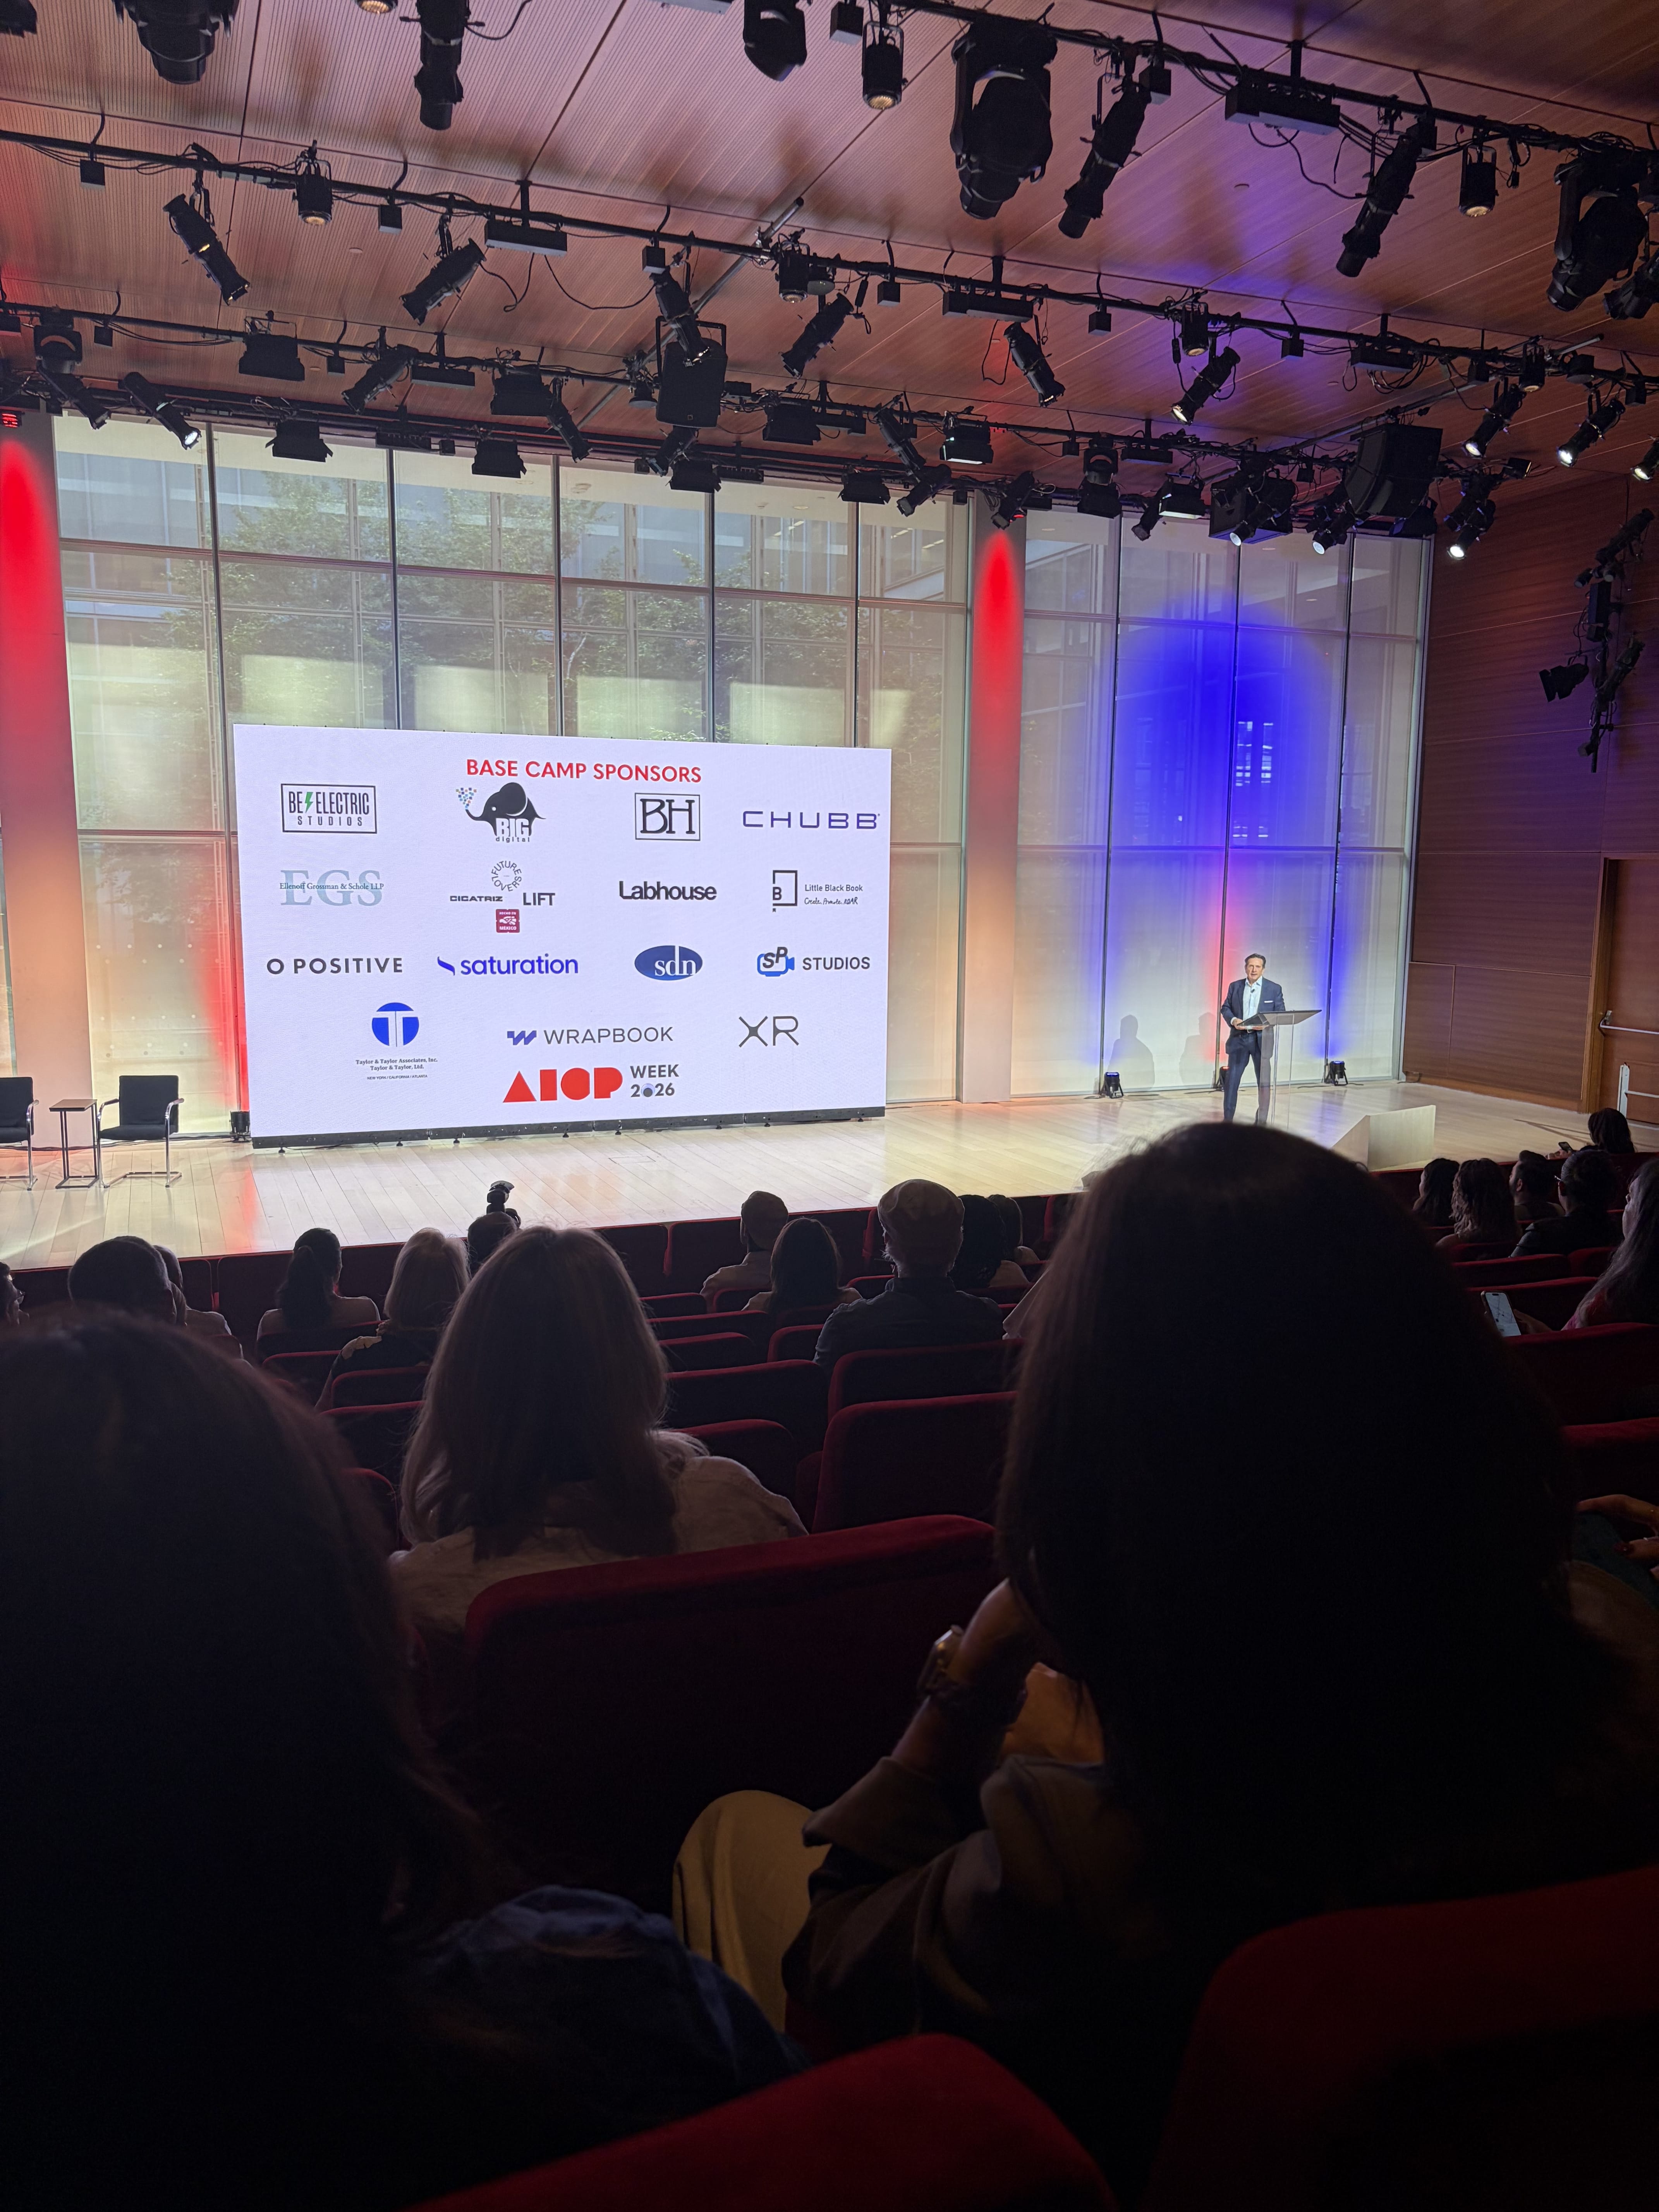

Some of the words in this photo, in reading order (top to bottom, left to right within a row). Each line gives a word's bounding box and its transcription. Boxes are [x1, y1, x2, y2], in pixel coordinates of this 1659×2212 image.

[467, 759, 518, 776] BASE
[526, 761, 587, 779] CAMP
[594, 763, 701, 783] SPONSORS
[289, 791, 303, 814] BE
[316, 792, 369, 815] ELECTRIC
[297, 816, 362, 826] STUDIOS
[640, 798, 696, 835] BH
[743, 811, 877, 829] CHUBB
[496, 818, 529, 837] BIG
[491, 860, 522, 876] FUTURE
[280, 870, 382, 906] EGS
[491, 876, 522, 891] LOVERS
[619, 881, 717, 900] Labhouse
[523, 892, 556, 906] LIFT
[266, 958, 284, 975] O
[294, 957, 403, 974] POSITIVE
[460, 953, 579, 975] saturation
[654, 945, 697, 977] sdn
[762, 946, 788, 969] SP
[802, 957, 870, 970] STUDIOS
[543, 1027, 673, 1044] WRAPBOOK
[738, 1016, 799, 1048] XR
[630, 1064, 679, 1079] WEEK
